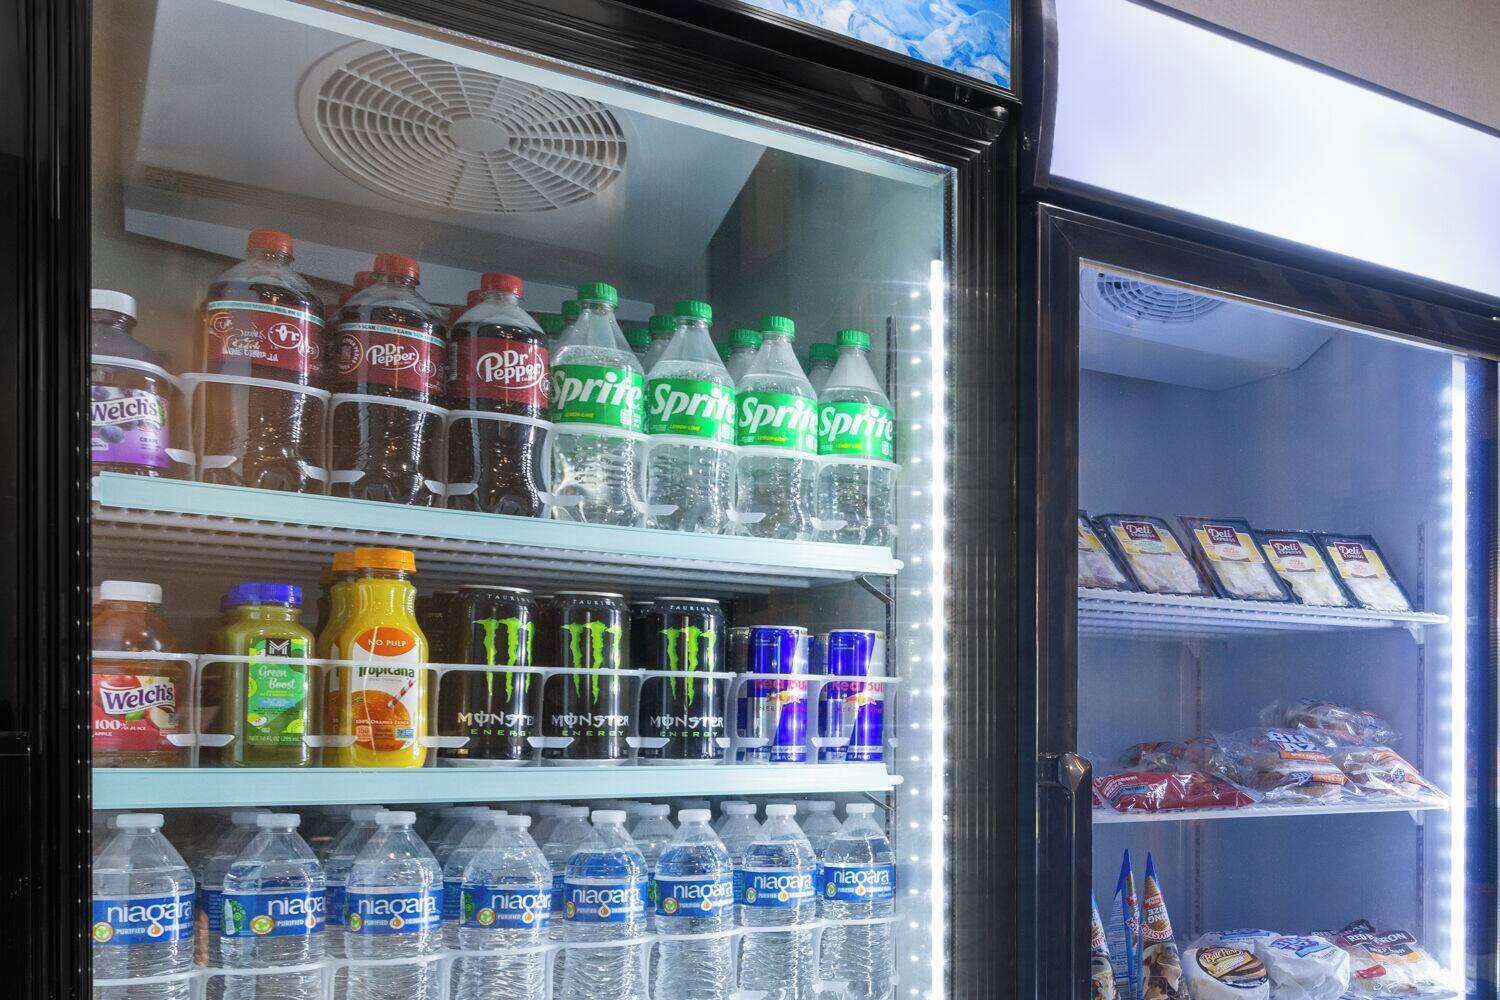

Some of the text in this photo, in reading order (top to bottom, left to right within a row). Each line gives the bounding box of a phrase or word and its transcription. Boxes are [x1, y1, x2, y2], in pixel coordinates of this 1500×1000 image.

[371, 345, 416, 366] Pepper
[385, 344, 404, 356] Dr
[504, 351, 529, 366] Dr
[484, 354, 542, 384] Pepper
[553, 370, 642, 410] Sprite
[651, 383, 735, 424] Sprite
[819, 406, 893, 442] Sprite
[1126, 524, 1152, 534] Deli
[1208, 528, 1234, 538] Deli
[1274, 543, 1299, 551] Deli
[1339, 546, 1360, 555] Deli
[259, 665, 287, 678] Green
[269, 677, 296, 690] Boost
[103, 685, 174, 710] Welch's
[552, 711, 630, 728] MONSTER
[651, 712, 723, 729] MONSTER
[659, 730, 718, 738] ENERGY
[754, 873, 813, 891] niagara
[834, 869, 890, 885] niagara
[572, 887, 641, 904] niagara
[673, 881, 733, 900] niagara
[358, 896, 437, 917] niagara
